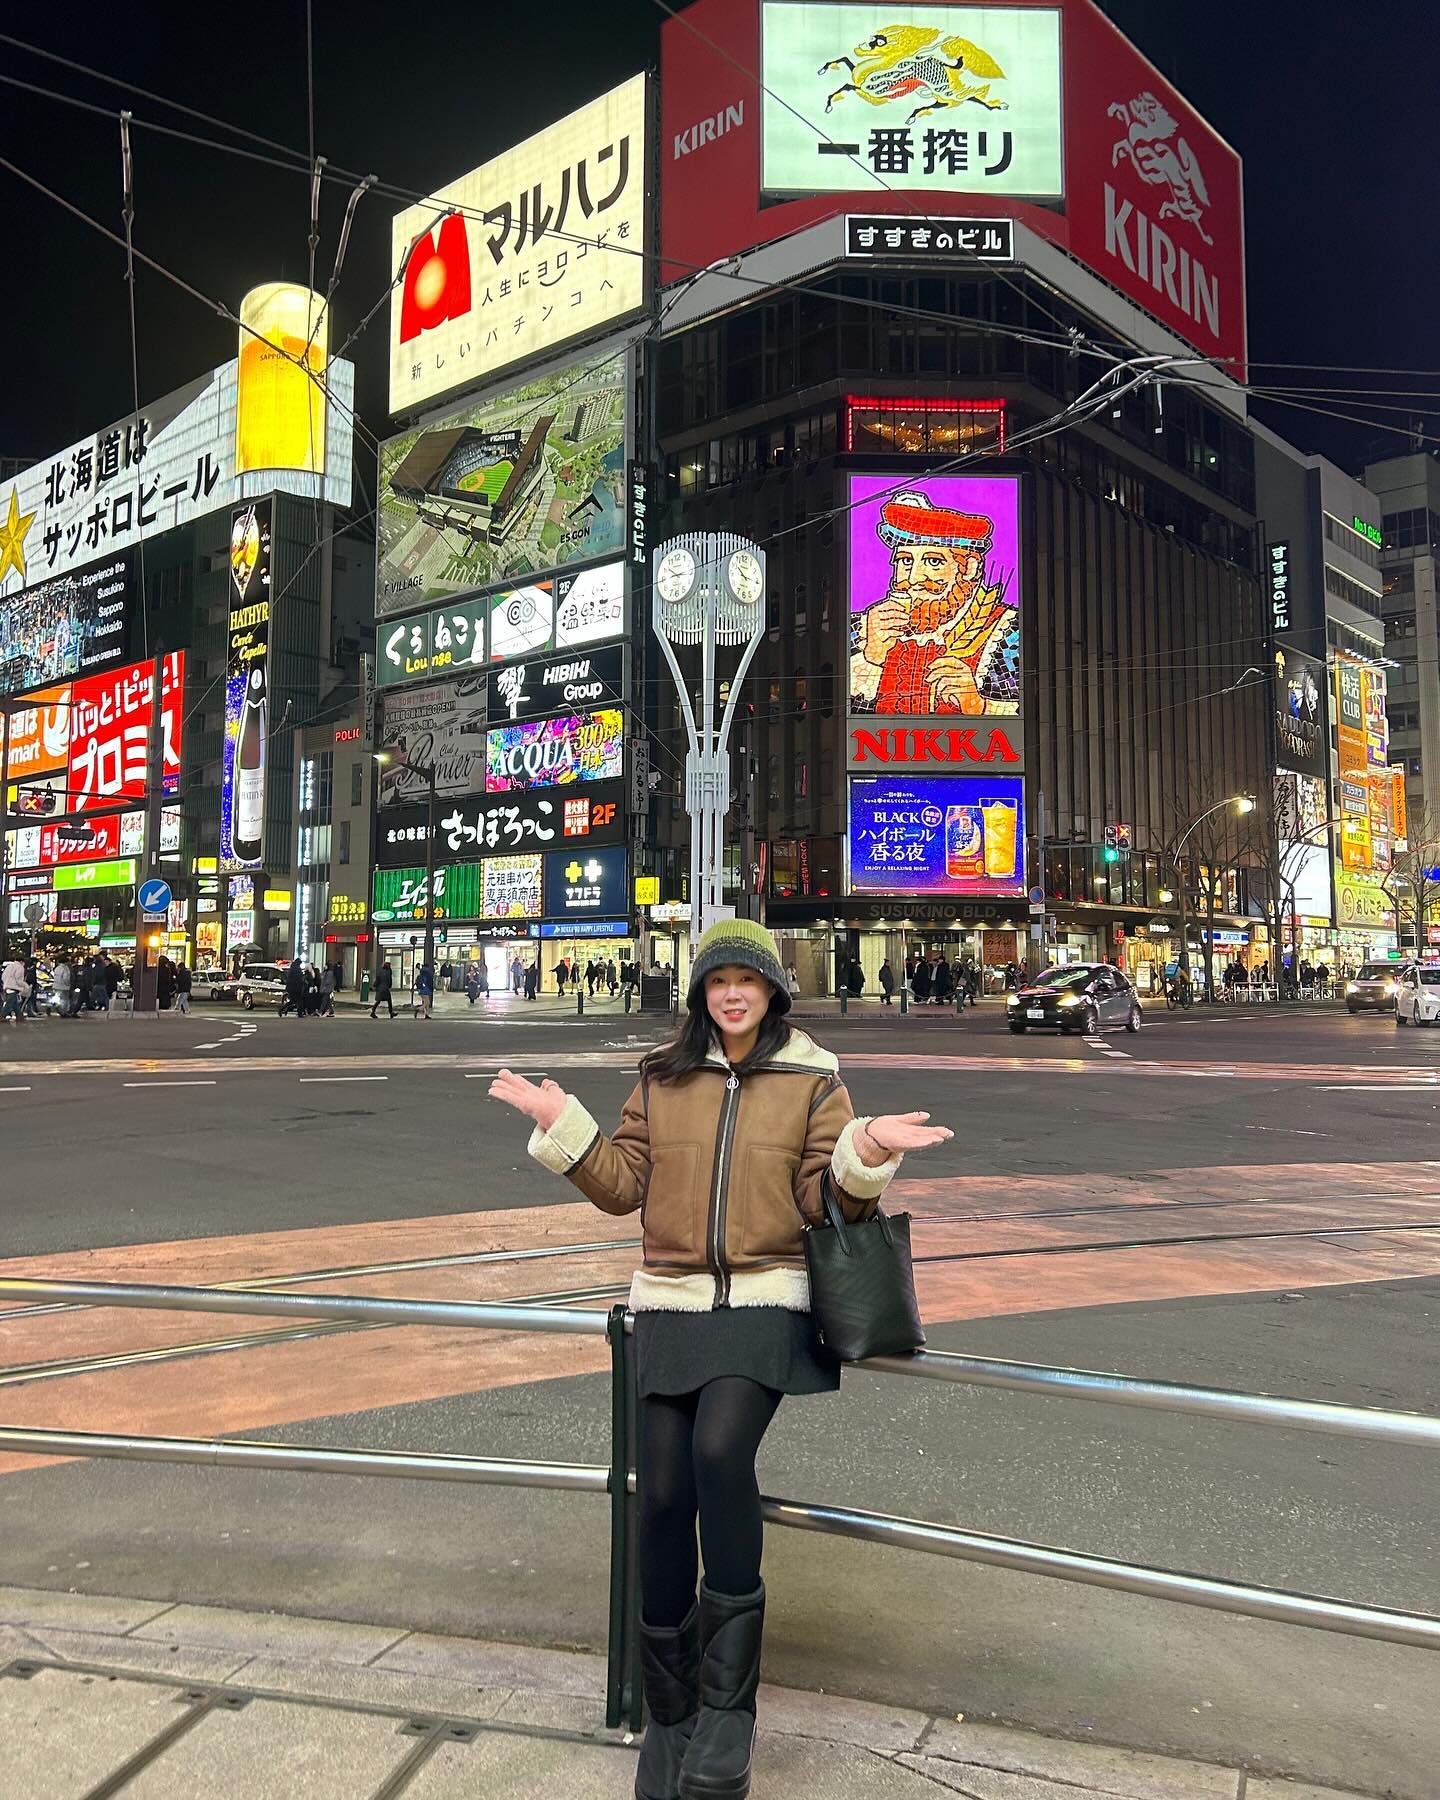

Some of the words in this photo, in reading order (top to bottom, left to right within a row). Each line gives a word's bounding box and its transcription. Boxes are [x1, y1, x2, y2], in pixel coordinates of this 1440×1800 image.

[674, 100, 745, 160] KIRIN
[817, 127, 1013, 176] 一番搾り
[483, 135, 629, 265] マルハン
[857, 226, 1002, 251] すすきのビル
[482, 221, 630, 307] 人生にヨロコビを
[1104, 182, 1220, 339] KIRIN
[411, 280, 613, 381] 新しいパチンコへ
[45, 418, 149, 509] 北海道は
[43, 452, 220, 568] サッポロビール
[82, 567, 114, 587] Experience
[115, 562, 126, 574] the
[384, 582, 389, 594] F
[391, 574, 424, 593] VILLAGE
[97, 582, 125, 600] Susukino
[559, 580, 571, 595] 2F
[1271, 546, 1289, 629] すすきのビル
[98, 601, 124, 618] Sapporo
[229, 601, 269, 631] HATHYR
[95, 620, 123, 638] Hokkaido
[386, 615, 469, 666] くろねこ
[405, 651, 452, 673] Lounge
[542, 660, 591, 686] HIBIKI
[563, 682, 603, 701] Group
[1341, 671, 1360, 699] 快活
[1342, 699, 1361, 719] CLUB
[491, 737, 575, 778] ACQUA
[850, 728, 1021, 762] NIKKA
[580, 748, 617, 773] 日本一
[441, 801, 555, 851] さっぽろっこ
[592, 803, 616, 825] 2F
[873, 811, 920, 823] BLACK
[858, 826, 936, 842] ハイボール
[868, 842, 926, 861] 香る夜
[75, 867, 97, 882] レイク
[565, 886, 601, 899] サツドラ
[870, 904, 956, 918] SUSUKINO
[963, 904, 1001, 918] BLD.
[594, 924, 614, 933] LIFESTYLE
